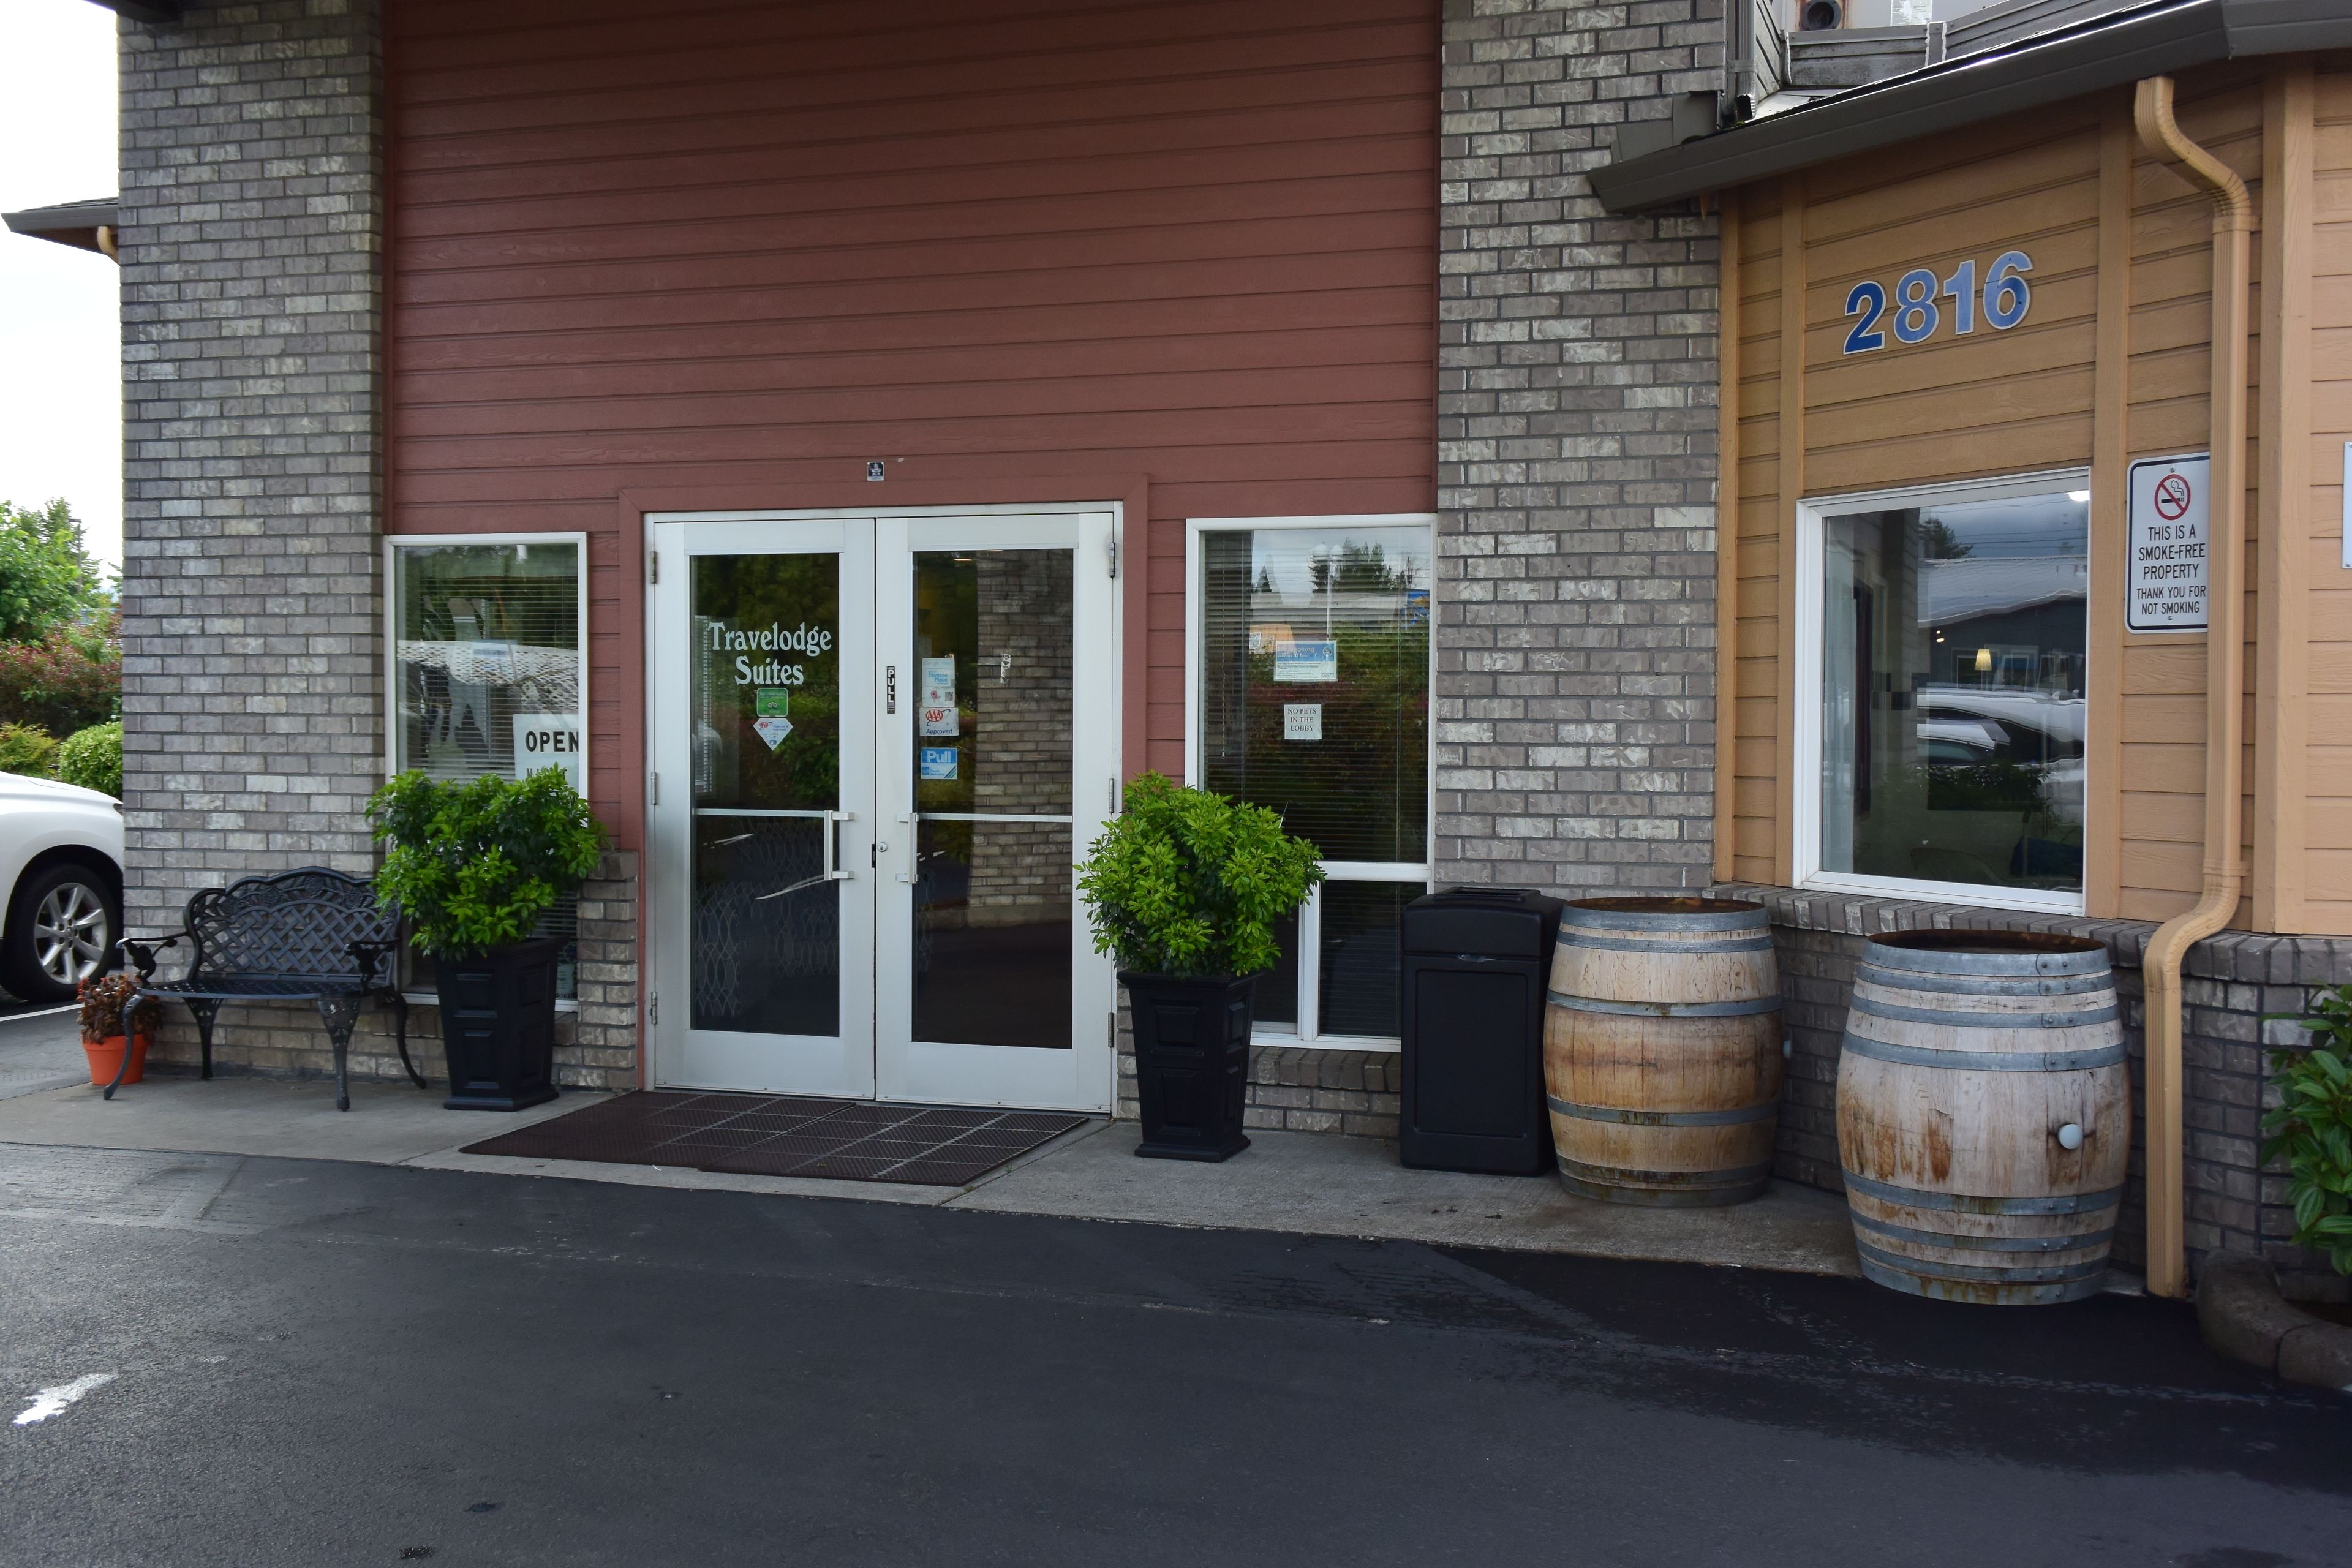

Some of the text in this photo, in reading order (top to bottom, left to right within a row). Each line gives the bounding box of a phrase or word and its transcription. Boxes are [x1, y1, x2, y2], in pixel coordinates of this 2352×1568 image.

[1842, 250, 2034, 355] 2816
[2148, 524, 2196, 541] THIS IS A
[2138, 543, 2206, 561] SMOKE-FREE
[2143, 563, 2199, 580] PROPERTY
[2136, 585, 2206, 600] THANK YOU FOR
[2141, 601, 2200, 615] NOT SMOKING
[708, 621, 832, 657] Travelodge
[735, 655, 804, 685] Suites
[927, 710, 942, 722] AAA
[525, 731, 579, 752] OPEN
[927, 750, 951, 763] Pull
